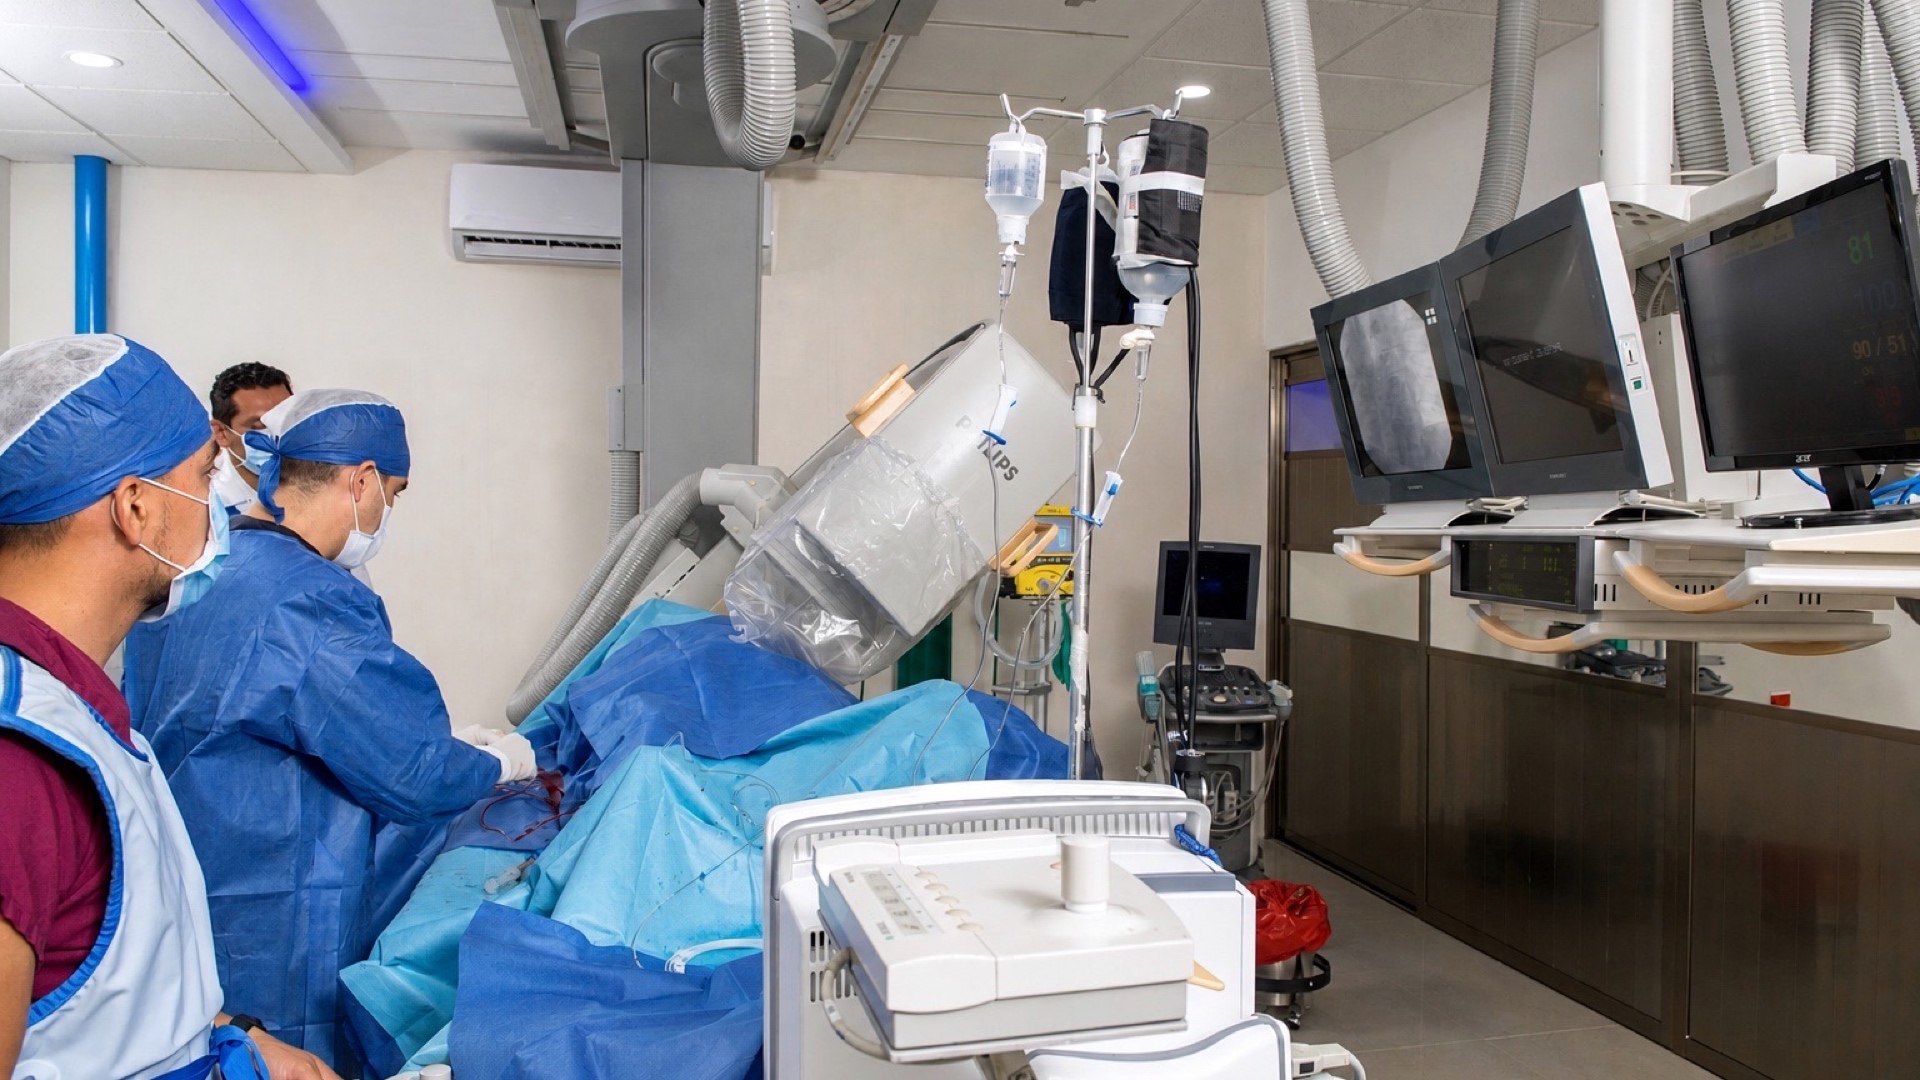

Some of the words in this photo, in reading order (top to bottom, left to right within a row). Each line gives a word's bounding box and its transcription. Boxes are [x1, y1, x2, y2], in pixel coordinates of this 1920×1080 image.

[1849, 230, 1874, 265] 81
[1854, 280, 1897, 315] 100
[1853, 339, 1871, 360] 90
[1887, 333, 1906, 355] 51
